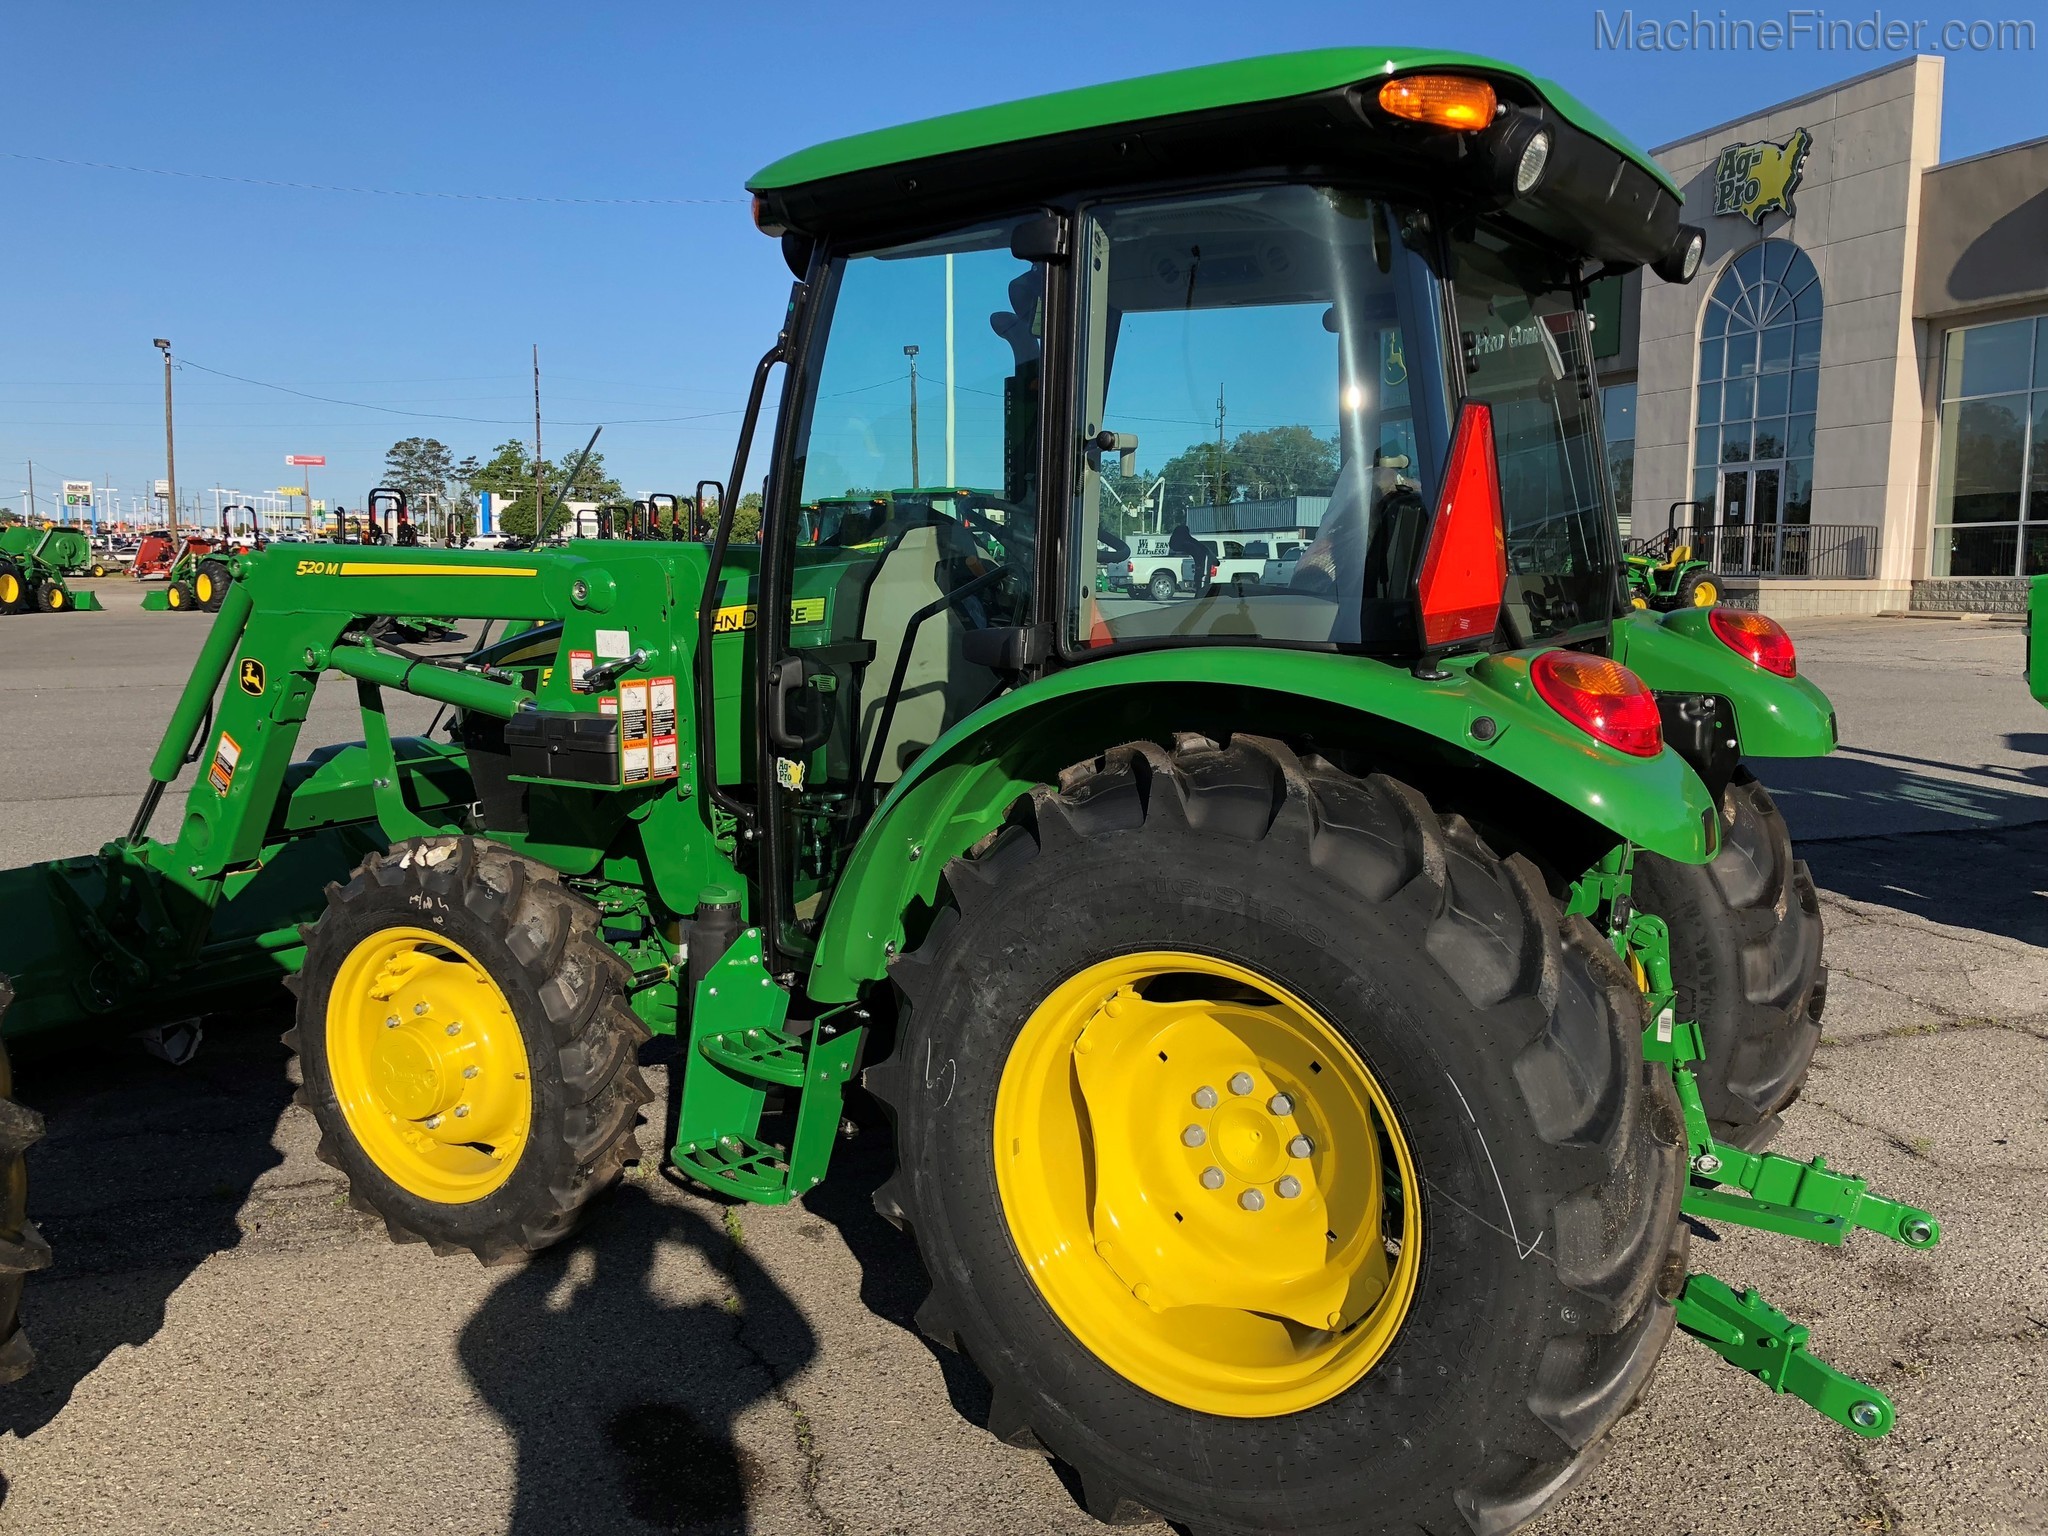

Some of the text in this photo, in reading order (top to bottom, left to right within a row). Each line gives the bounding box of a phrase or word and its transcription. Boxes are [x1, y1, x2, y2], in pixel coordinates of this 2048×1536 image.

[1719, 149, 1762, 183] Ag-
[1717, 180, 1760, 212] Pro
[296, 560, 340, 576] 520 M
